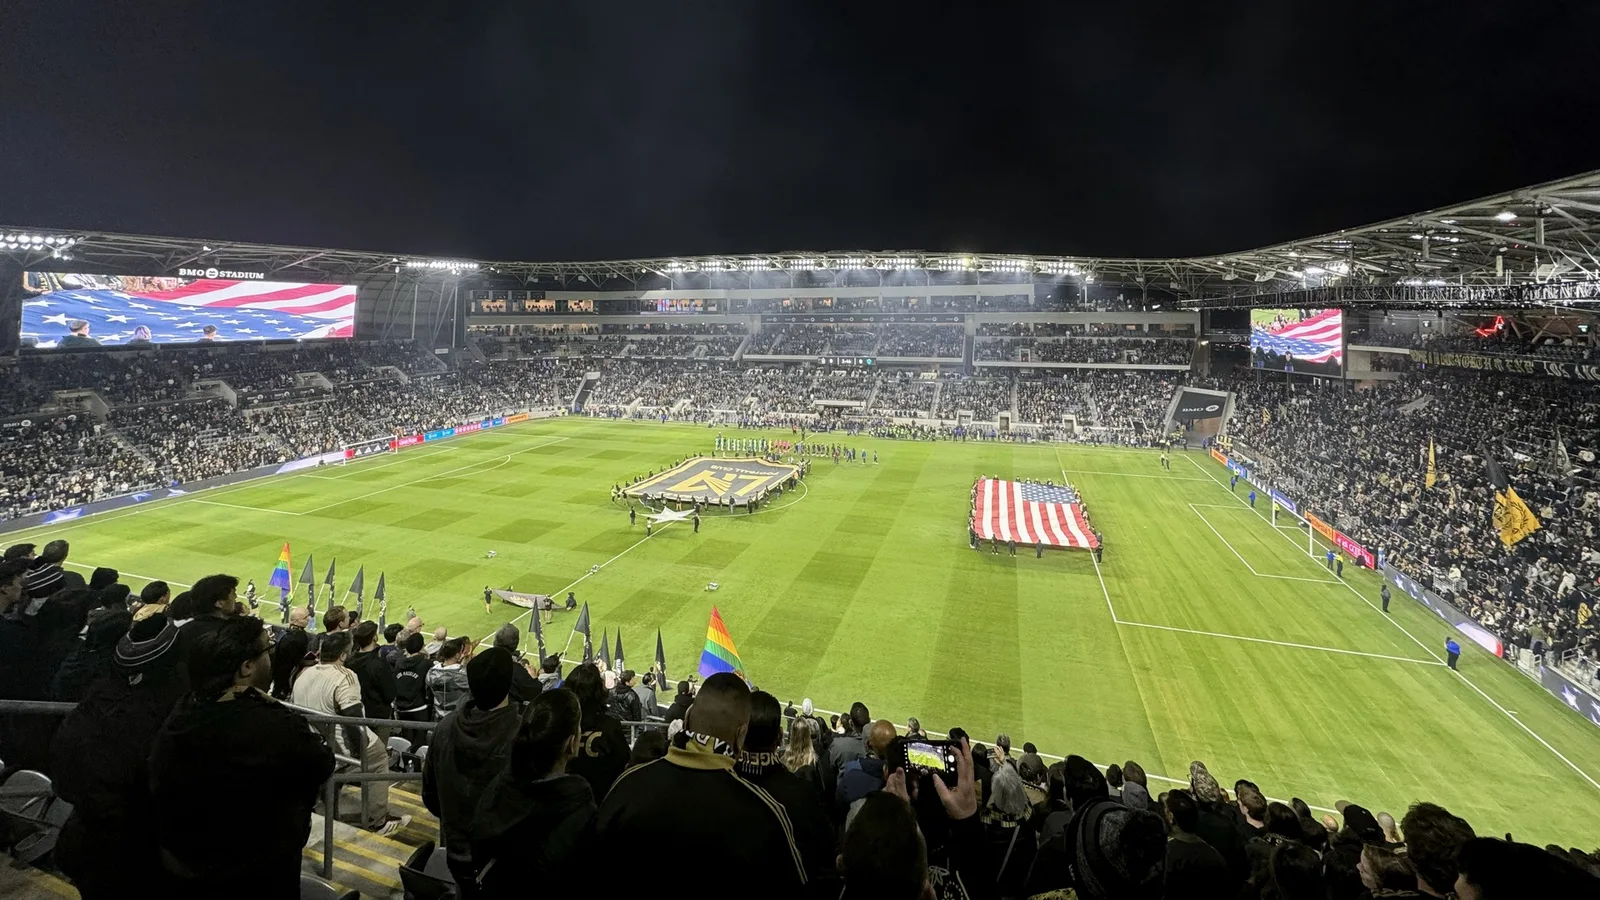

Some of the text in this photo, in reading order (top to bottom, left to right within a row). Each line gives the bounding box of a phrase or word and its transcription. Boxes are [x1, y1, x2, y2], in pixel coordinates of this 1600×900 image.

[179, 268, 265, 279] BMO STADIUM
[710, 464, 779, 476] FOOTBALL CLUB
